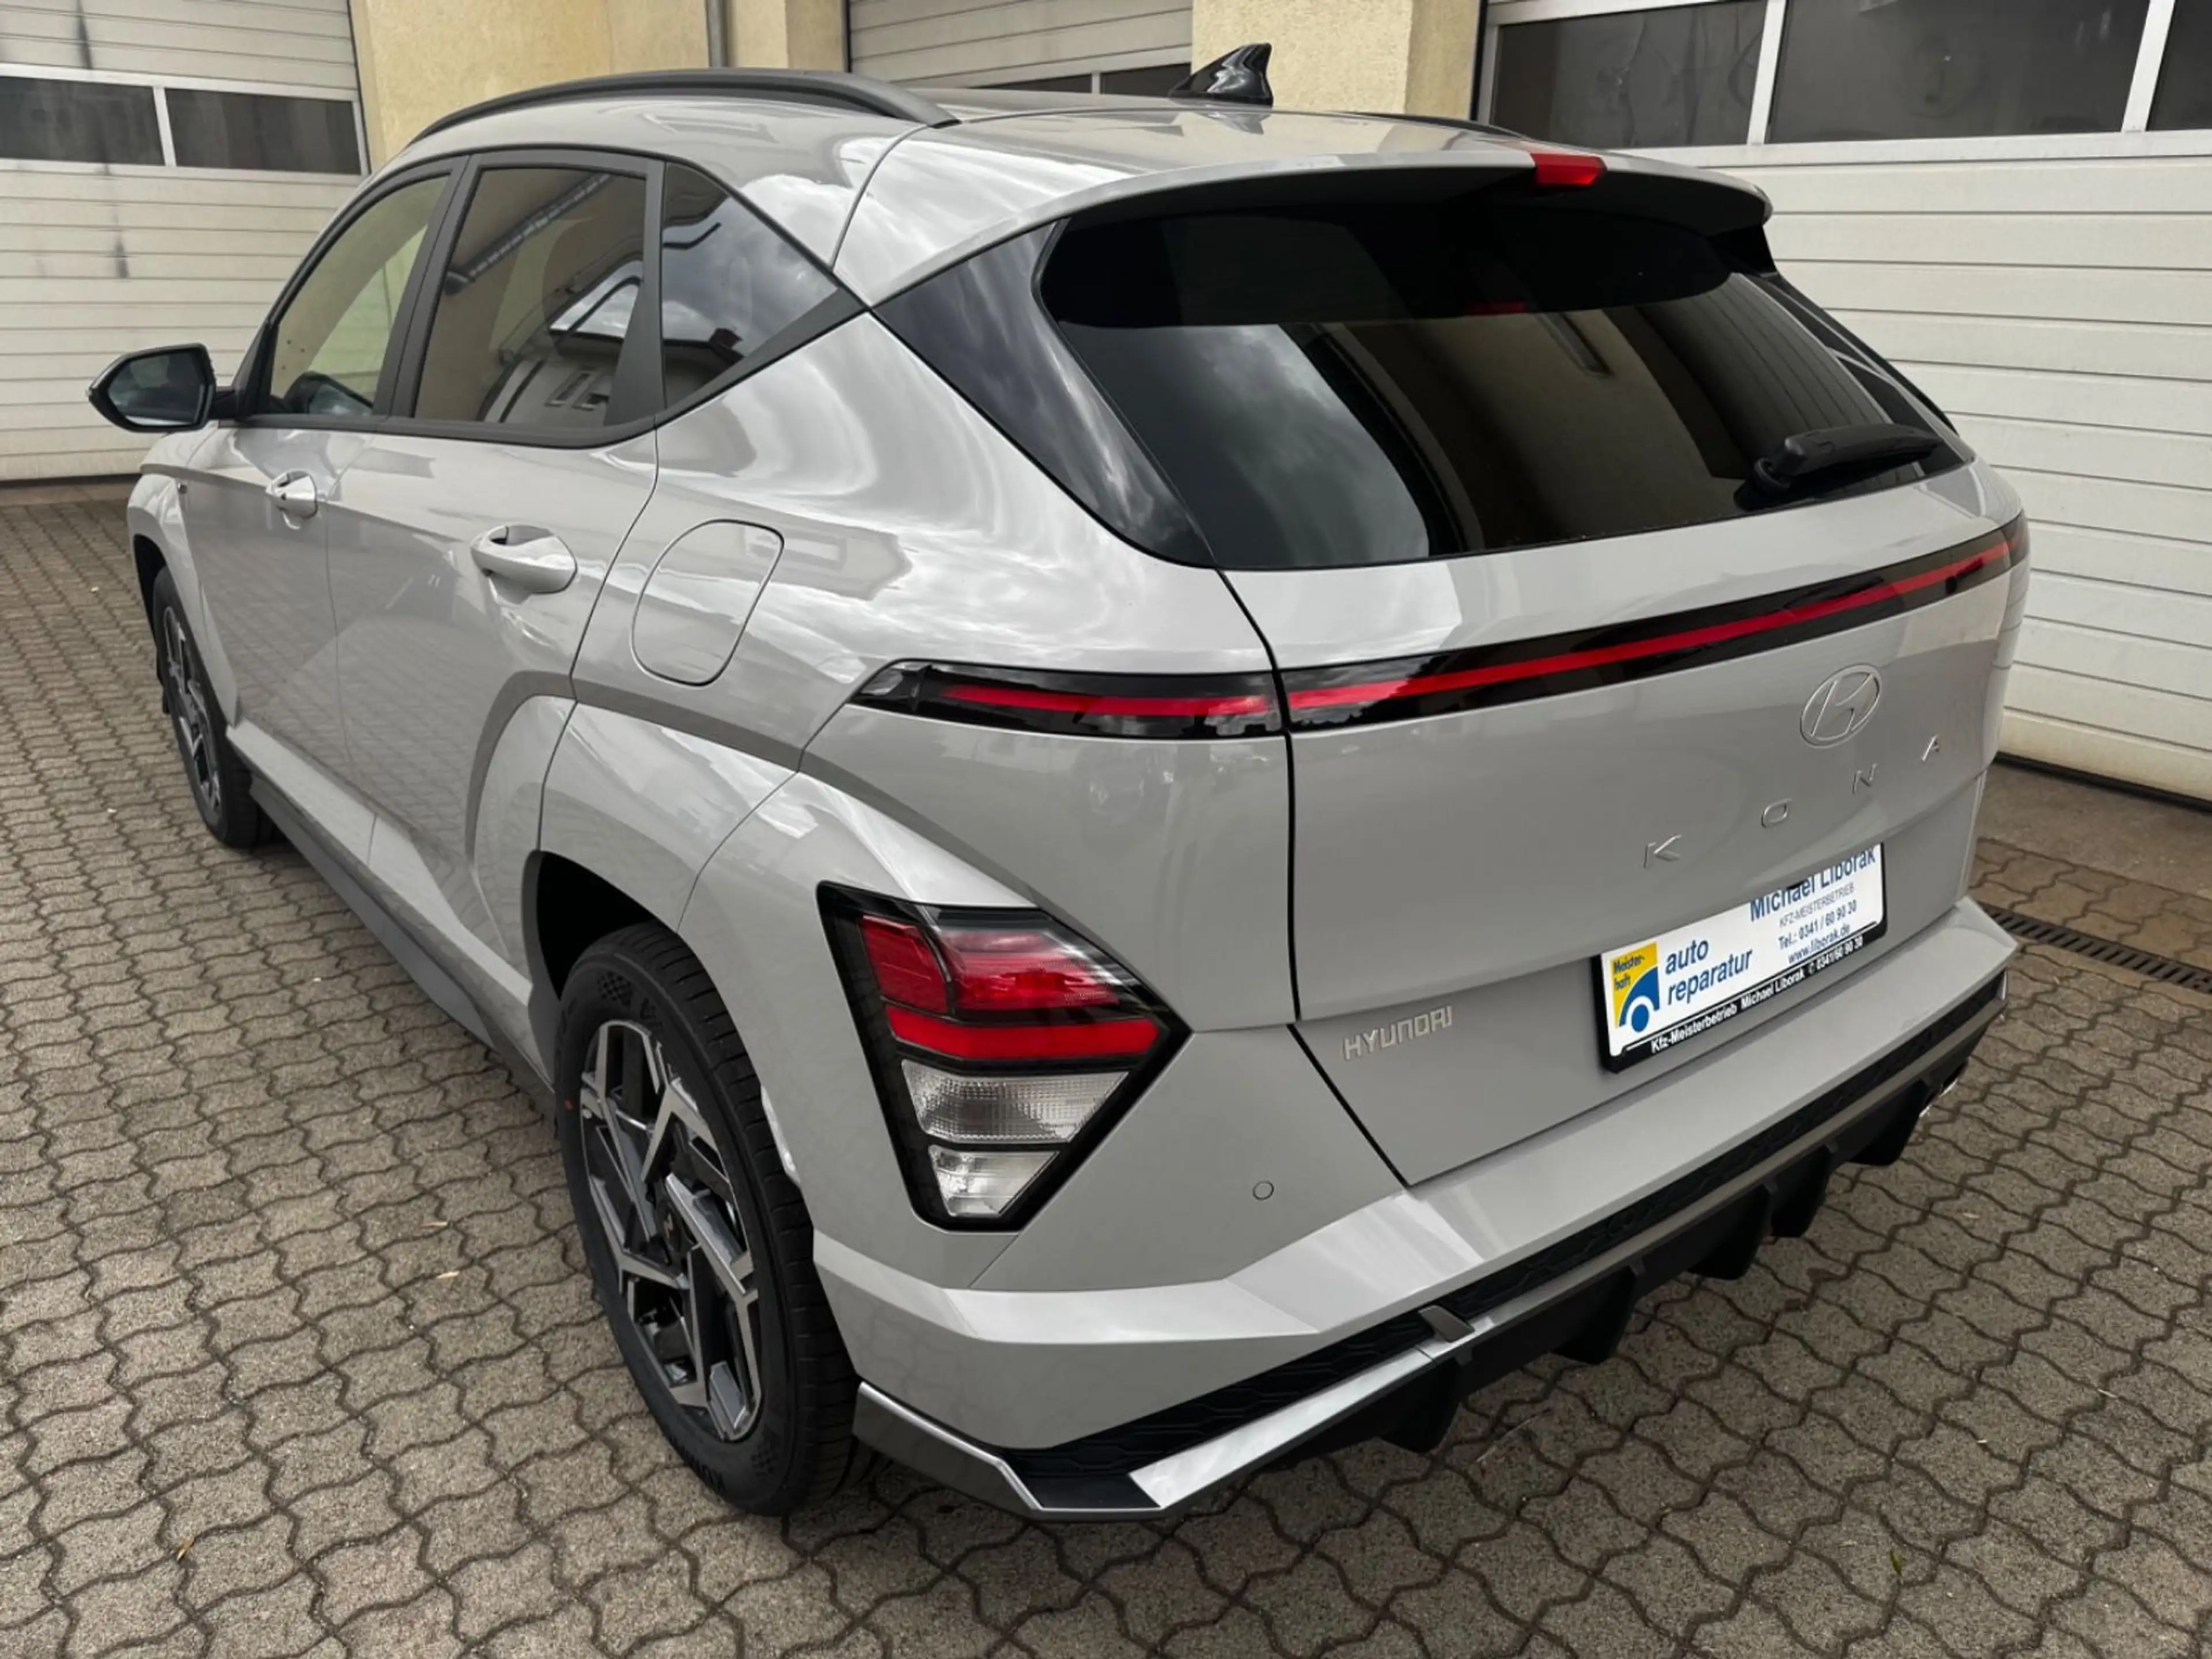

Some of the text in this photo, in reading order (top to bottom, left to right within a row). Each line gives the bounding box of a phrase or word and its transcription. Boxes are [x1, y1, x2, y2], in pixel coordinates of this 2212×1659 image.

[1750, 848, 1876, 922] Michael Liborak
[1787, 923, 1850, 964] www.liborak.de
[1799, 919, 1818, 940] 0341
[1825, 911, 1835, 927] 60
[1665, 940, 1709, 975] auto
[1668, 949, 1753, 1005] reparatur
[1343, 1005, 1453, 1060] HYUNDAI
[1650, 1003, 1737, 1054] Kfz-Meisterbetrieb
[1740, 983, 1774, 1009] Michael
[1775, 968, 1805, 993] Liborak
